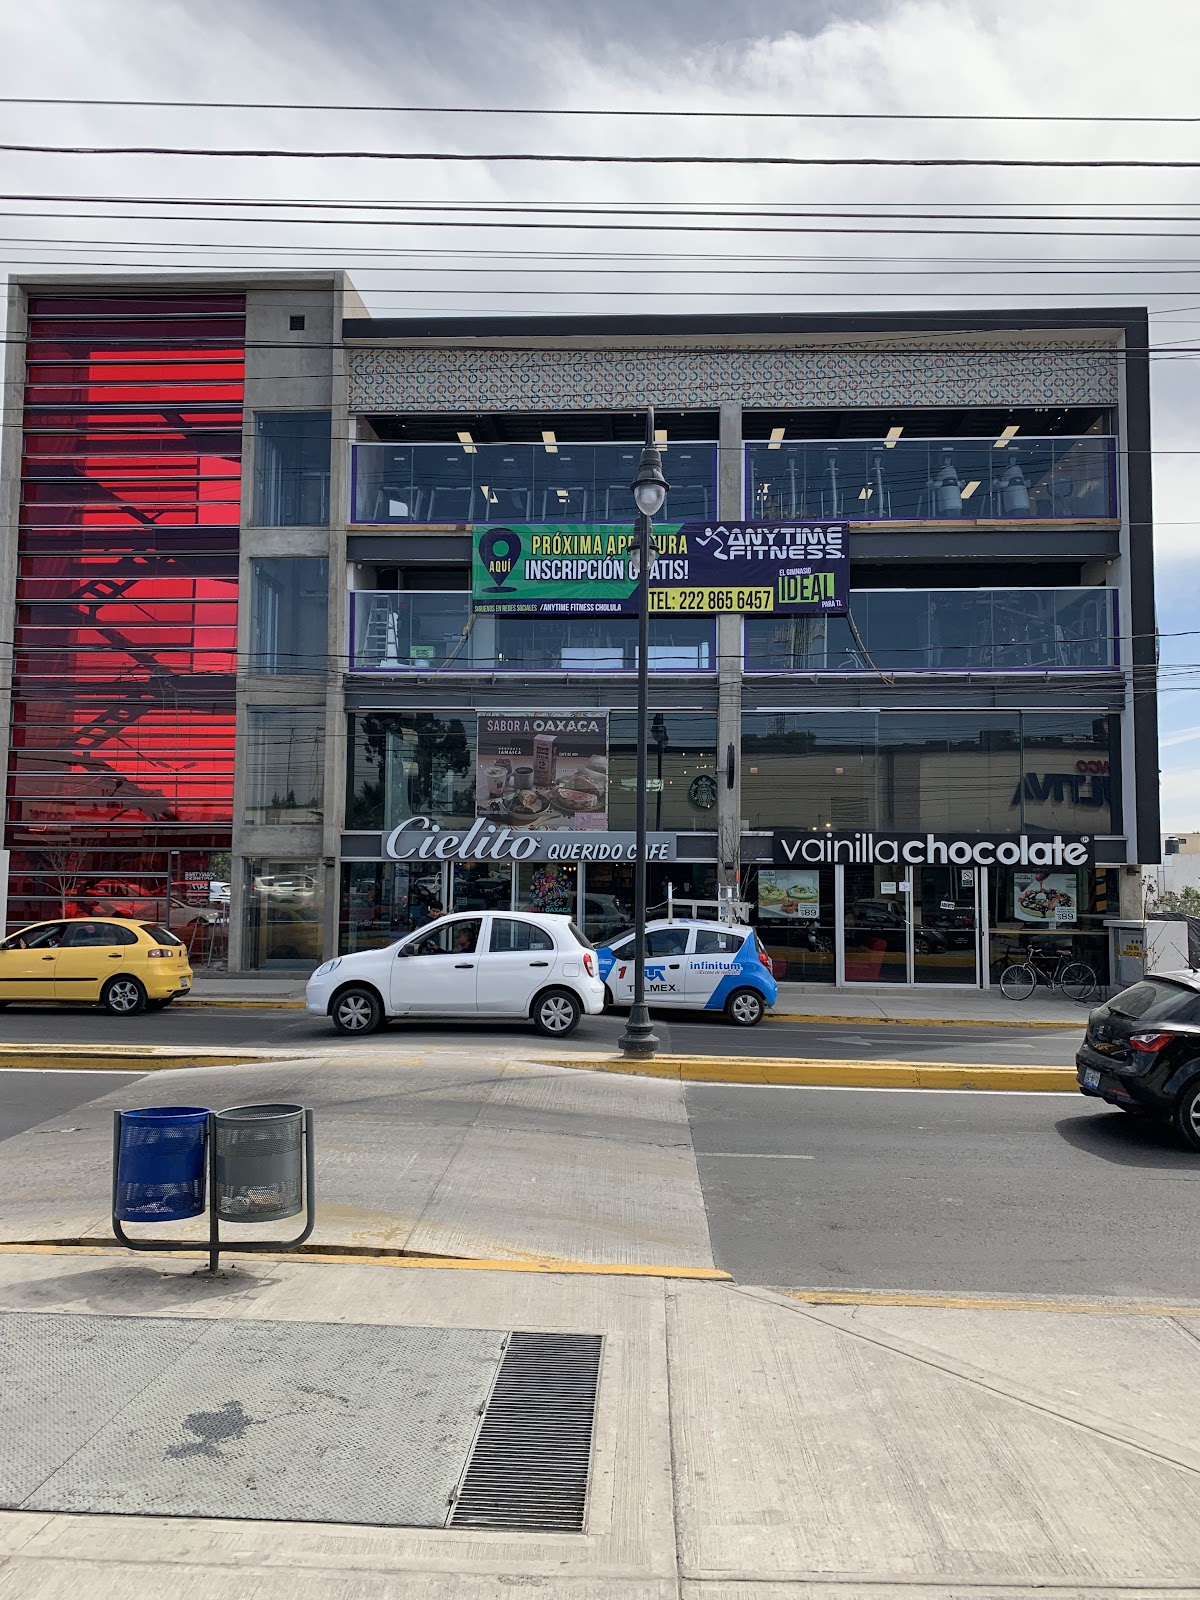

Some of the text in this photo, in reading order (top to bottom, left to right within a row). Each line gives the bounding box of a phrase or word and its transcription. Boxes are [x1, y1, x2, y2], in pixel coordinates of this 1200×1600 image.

[532, 532, 601, 555] PRÓXIMA
[727, 526, 842, 546] ANYTIME
[489, 558, 511, 573] AQUÍ
[525, 555, 689, 580] INSCRIPCIÓN GATIS!
[779, 567, 812, 577] EL GIMNASIO
[781, 574, 834, 601] IDEAL
[570, 603, 595, 612] FITNESS
[595, 603, 622, 612] CHOLULA
[649, 590, 771, 610] TEL: 222 865 6457
[821, 600, 836, 608] PARA
[487, 720, 600, 732] SABOR A OAXACA
[386, 816, 541, 860] Cielito
[547, 843, 623, 861] QUERIDO
[618, 966, 628, 980] 1
